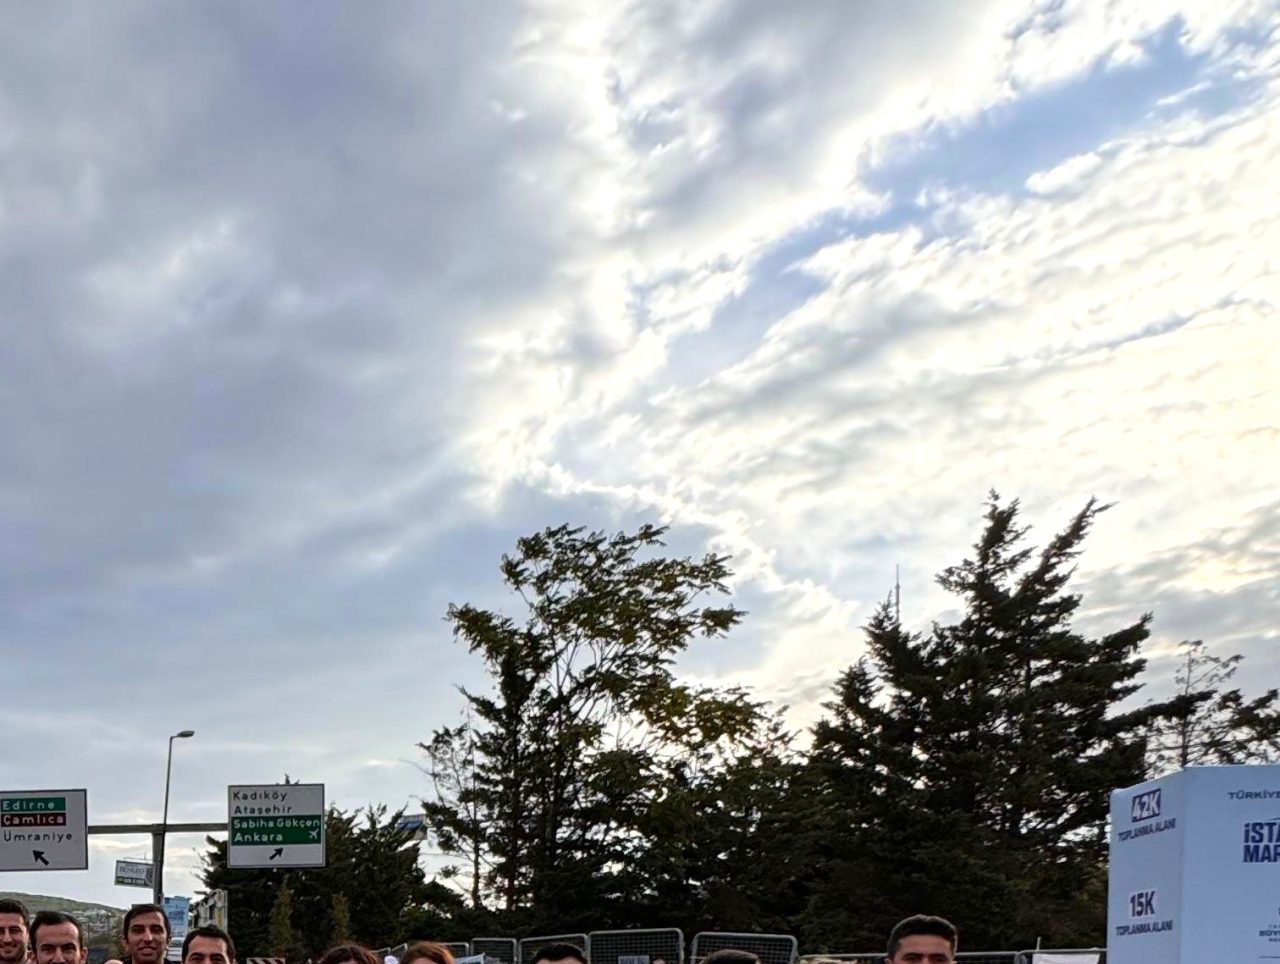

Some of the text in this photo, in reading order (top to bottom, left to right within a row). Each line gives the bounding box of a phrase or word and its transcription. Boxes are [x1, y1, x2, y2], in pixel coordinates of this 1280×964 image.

[233, 791, 287, 801] Kadıköy
[2, 800, 55, 811] Edirne
[234, 805, 292, 815] Ataşehir
[1132, 791, 1160, 820] 42K
[3, 815, 64, 825] Çamlıca
[233, 818, 320, 829] Sabiha Gökçen
[3, 830, 73, 843] Ümraniye
[234, 832, 283, 842] Ankara
[1130, 890, 1156, 917] 15K
